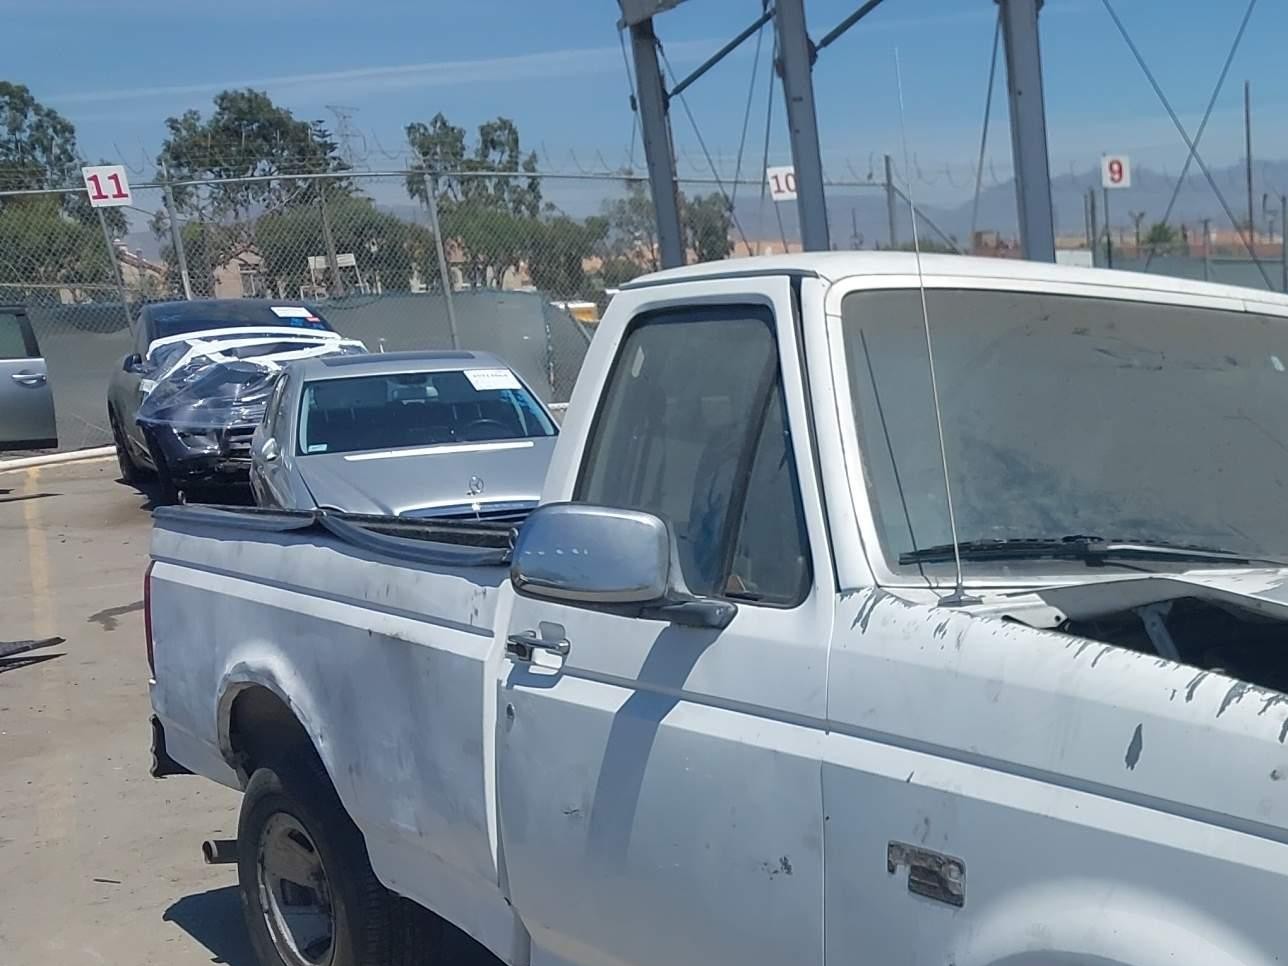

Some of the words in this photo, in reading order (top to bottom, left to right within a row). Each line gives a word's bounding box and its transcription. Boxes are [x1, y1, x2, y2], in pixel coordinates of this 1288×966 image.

[770, 172, 798, 194] 10
[1108, 159, 1123, 184] 9
[86, 172, 129, 200] 11
